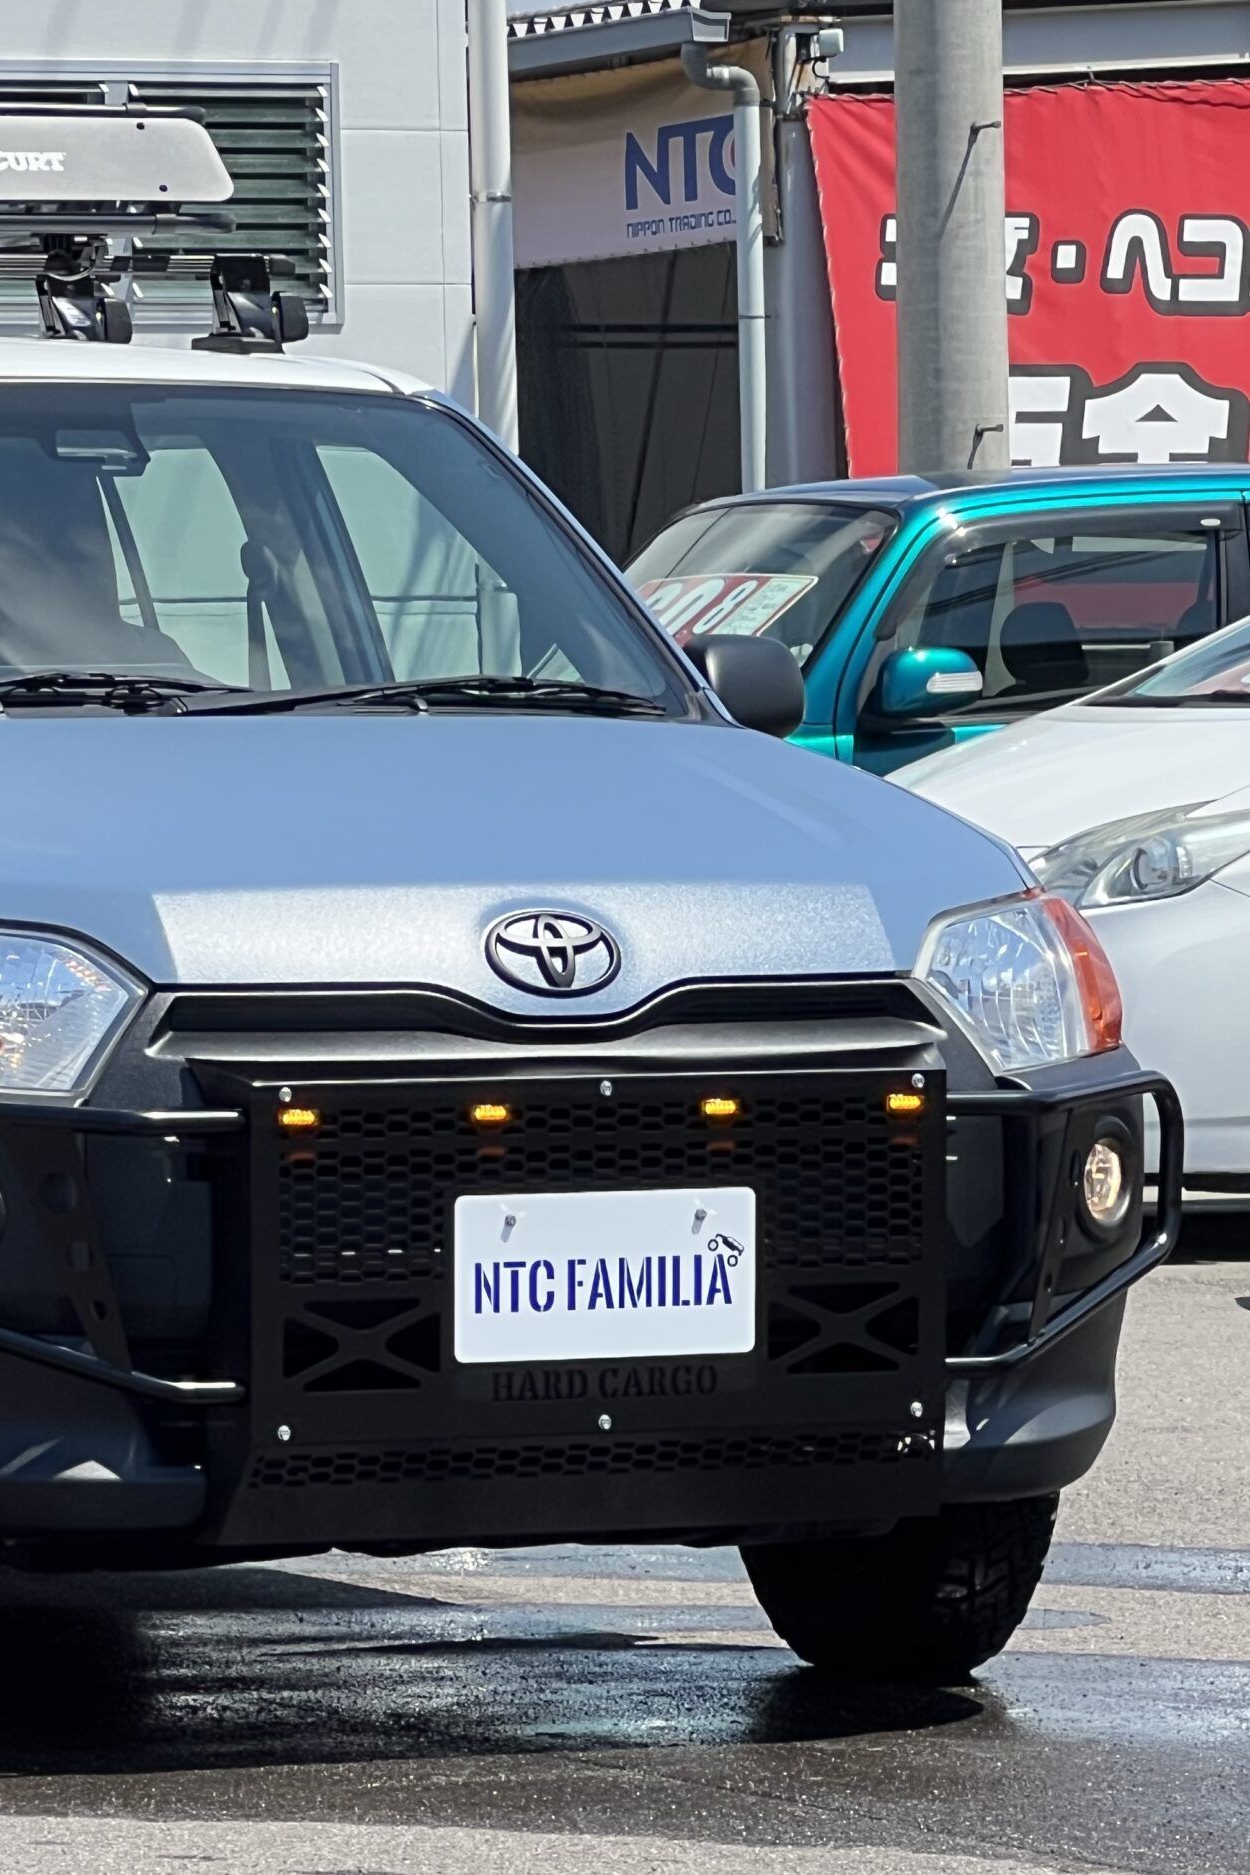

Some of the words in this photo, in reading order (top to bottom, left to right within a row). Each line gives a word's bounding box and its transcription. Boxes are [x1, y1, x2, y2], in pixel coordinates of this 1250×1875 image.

[626, 219, 665, 238] NIPPON
[668, 211, 714, 232] TRADING
[475, 1260, 554, 1314] NTC
[567, 1254, 732, 1311] FAMILIA
[491, 1369, 588, 1401] HARD
[598, 1365, 718, 1398] CARGO
